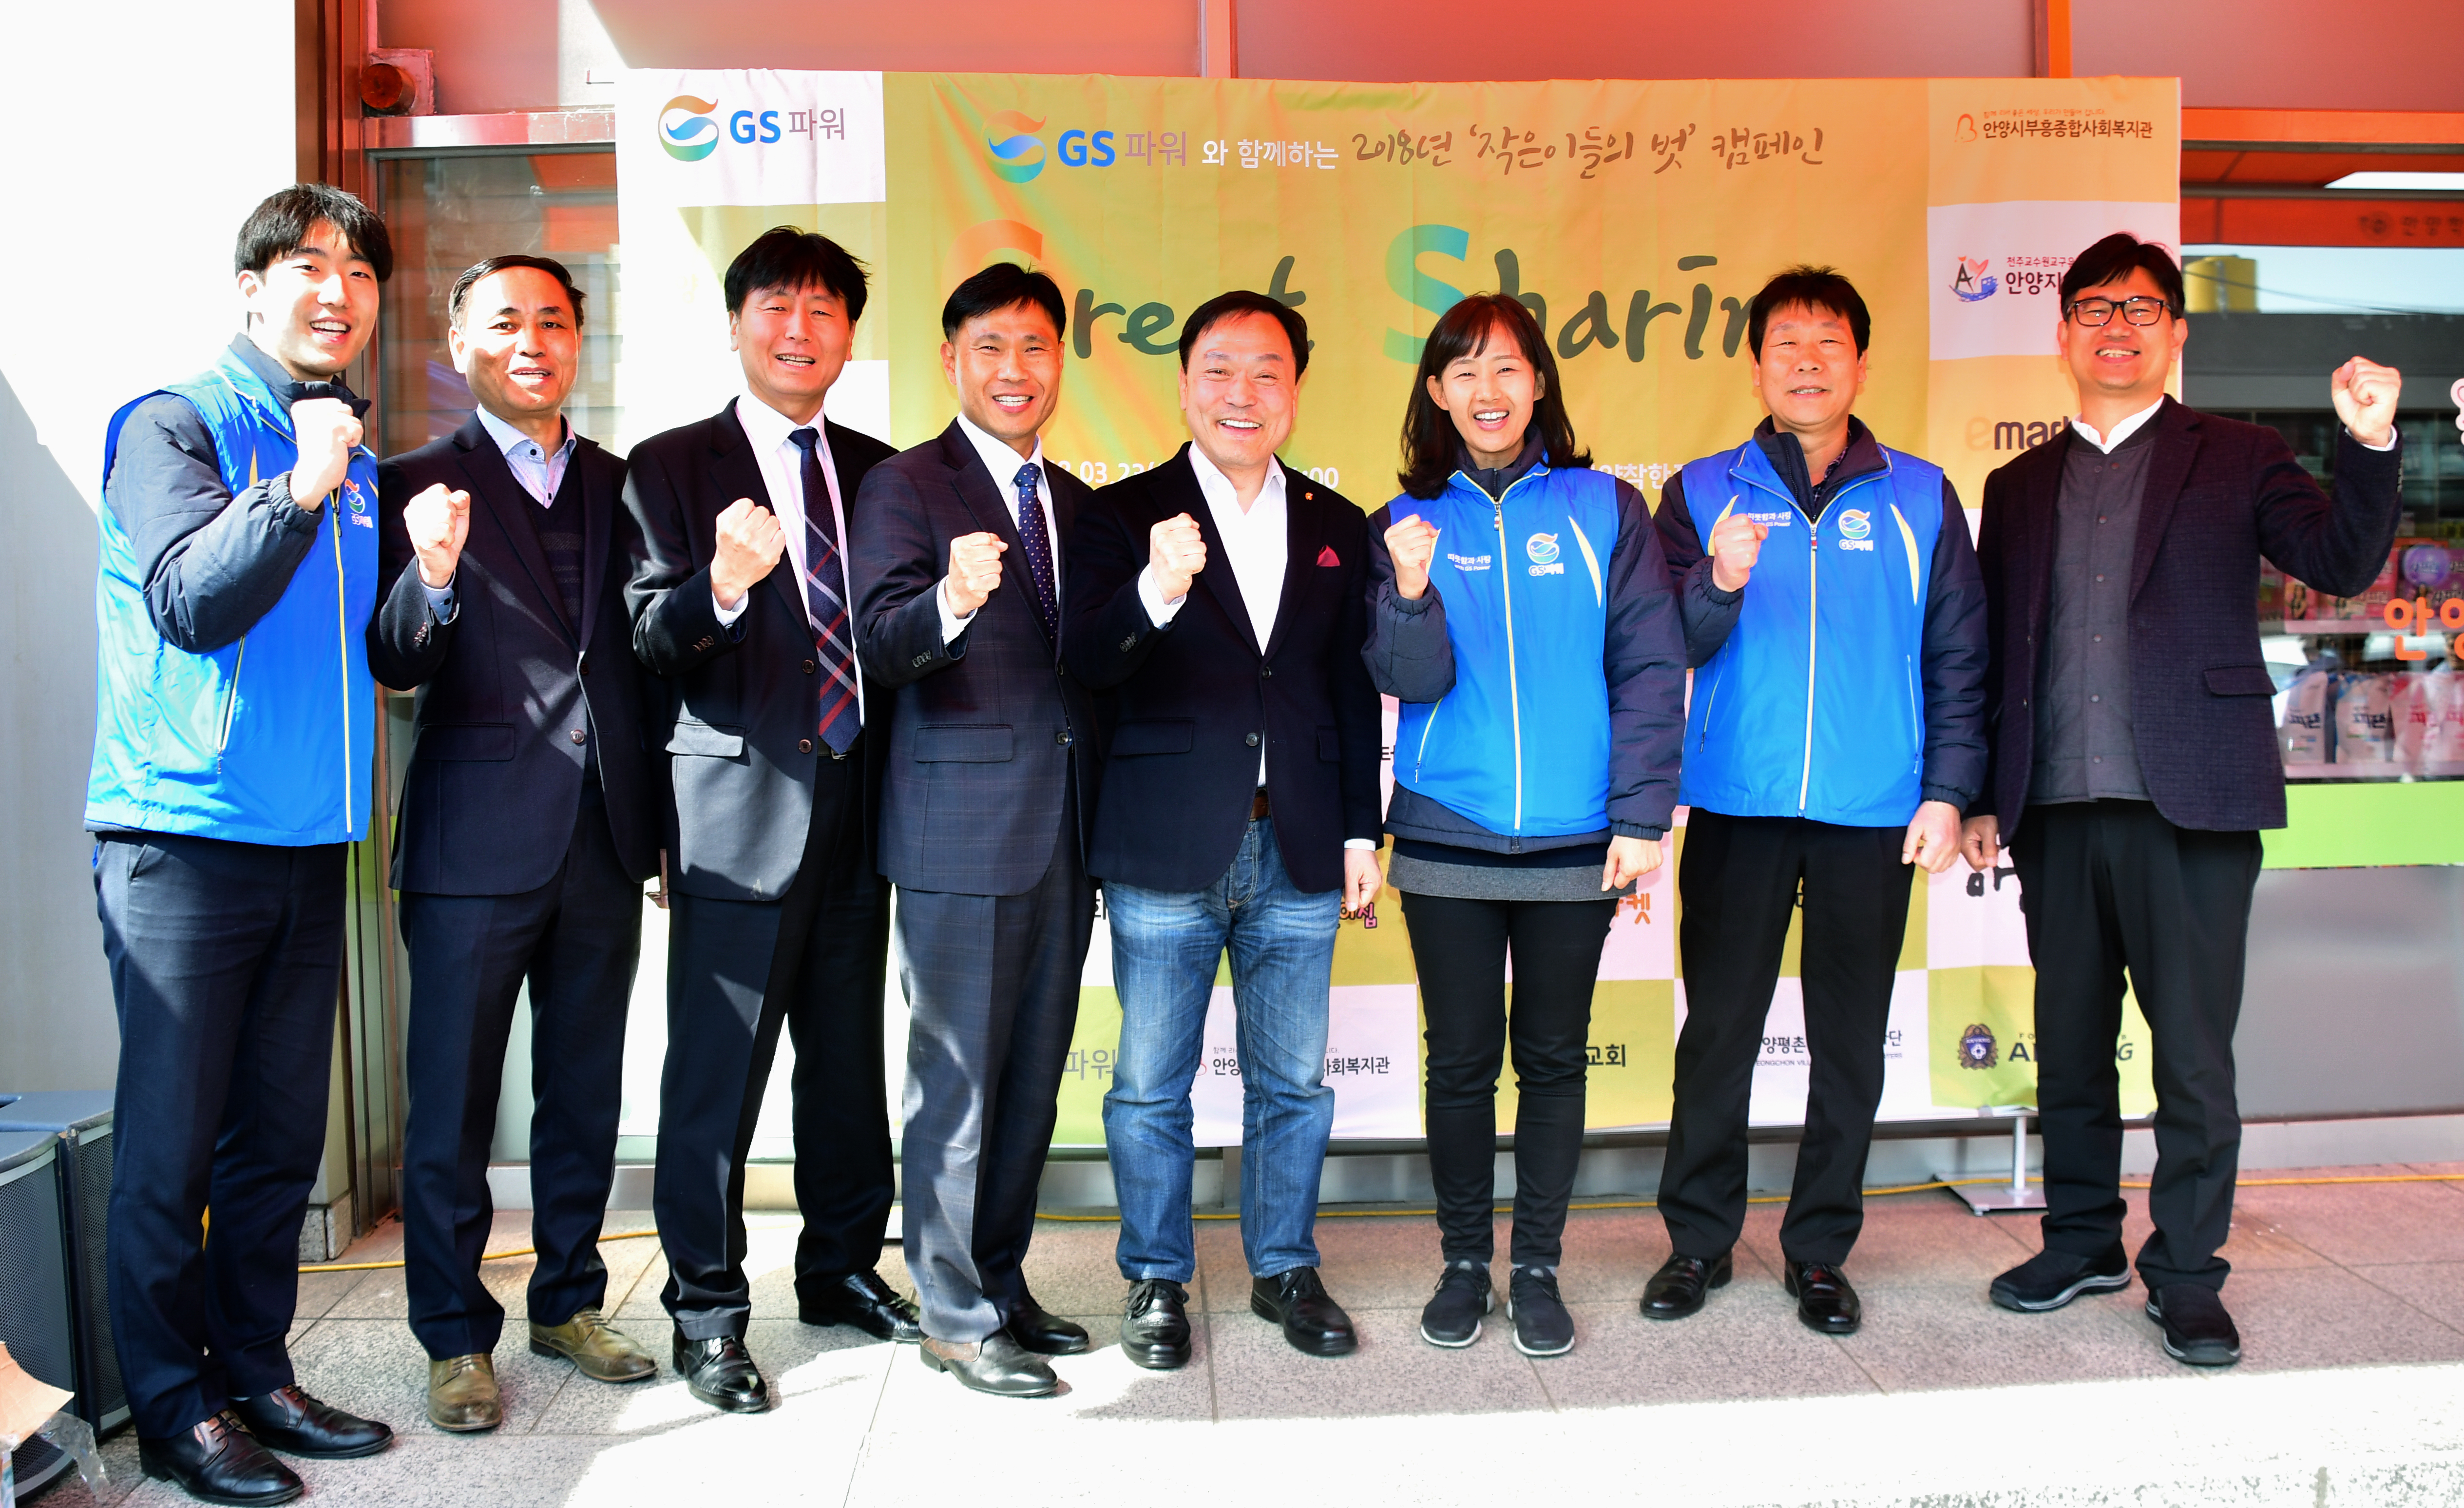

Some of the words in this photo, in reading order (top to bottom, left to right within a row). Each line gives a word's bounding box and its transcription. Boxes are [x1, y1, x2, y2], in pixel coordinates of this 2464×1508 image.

[729, 110, 781, 144] GS
[788, 108, 845, 141] 파워
[1983, 119, 2153, 138] 안양시부흥종합사회복지관
[1057, 129, 1116, 167] GS
[1125, 130, 1186, 167] 파워
[1202, 140, 1228, 166] 와
[1238, 139, 1339, 169] 함께하는
[1352, 129, 1452, 167] 2018년
[1711, 127, 1823, 170] 캠페인
[1965, 416, 2069, 451] emar
